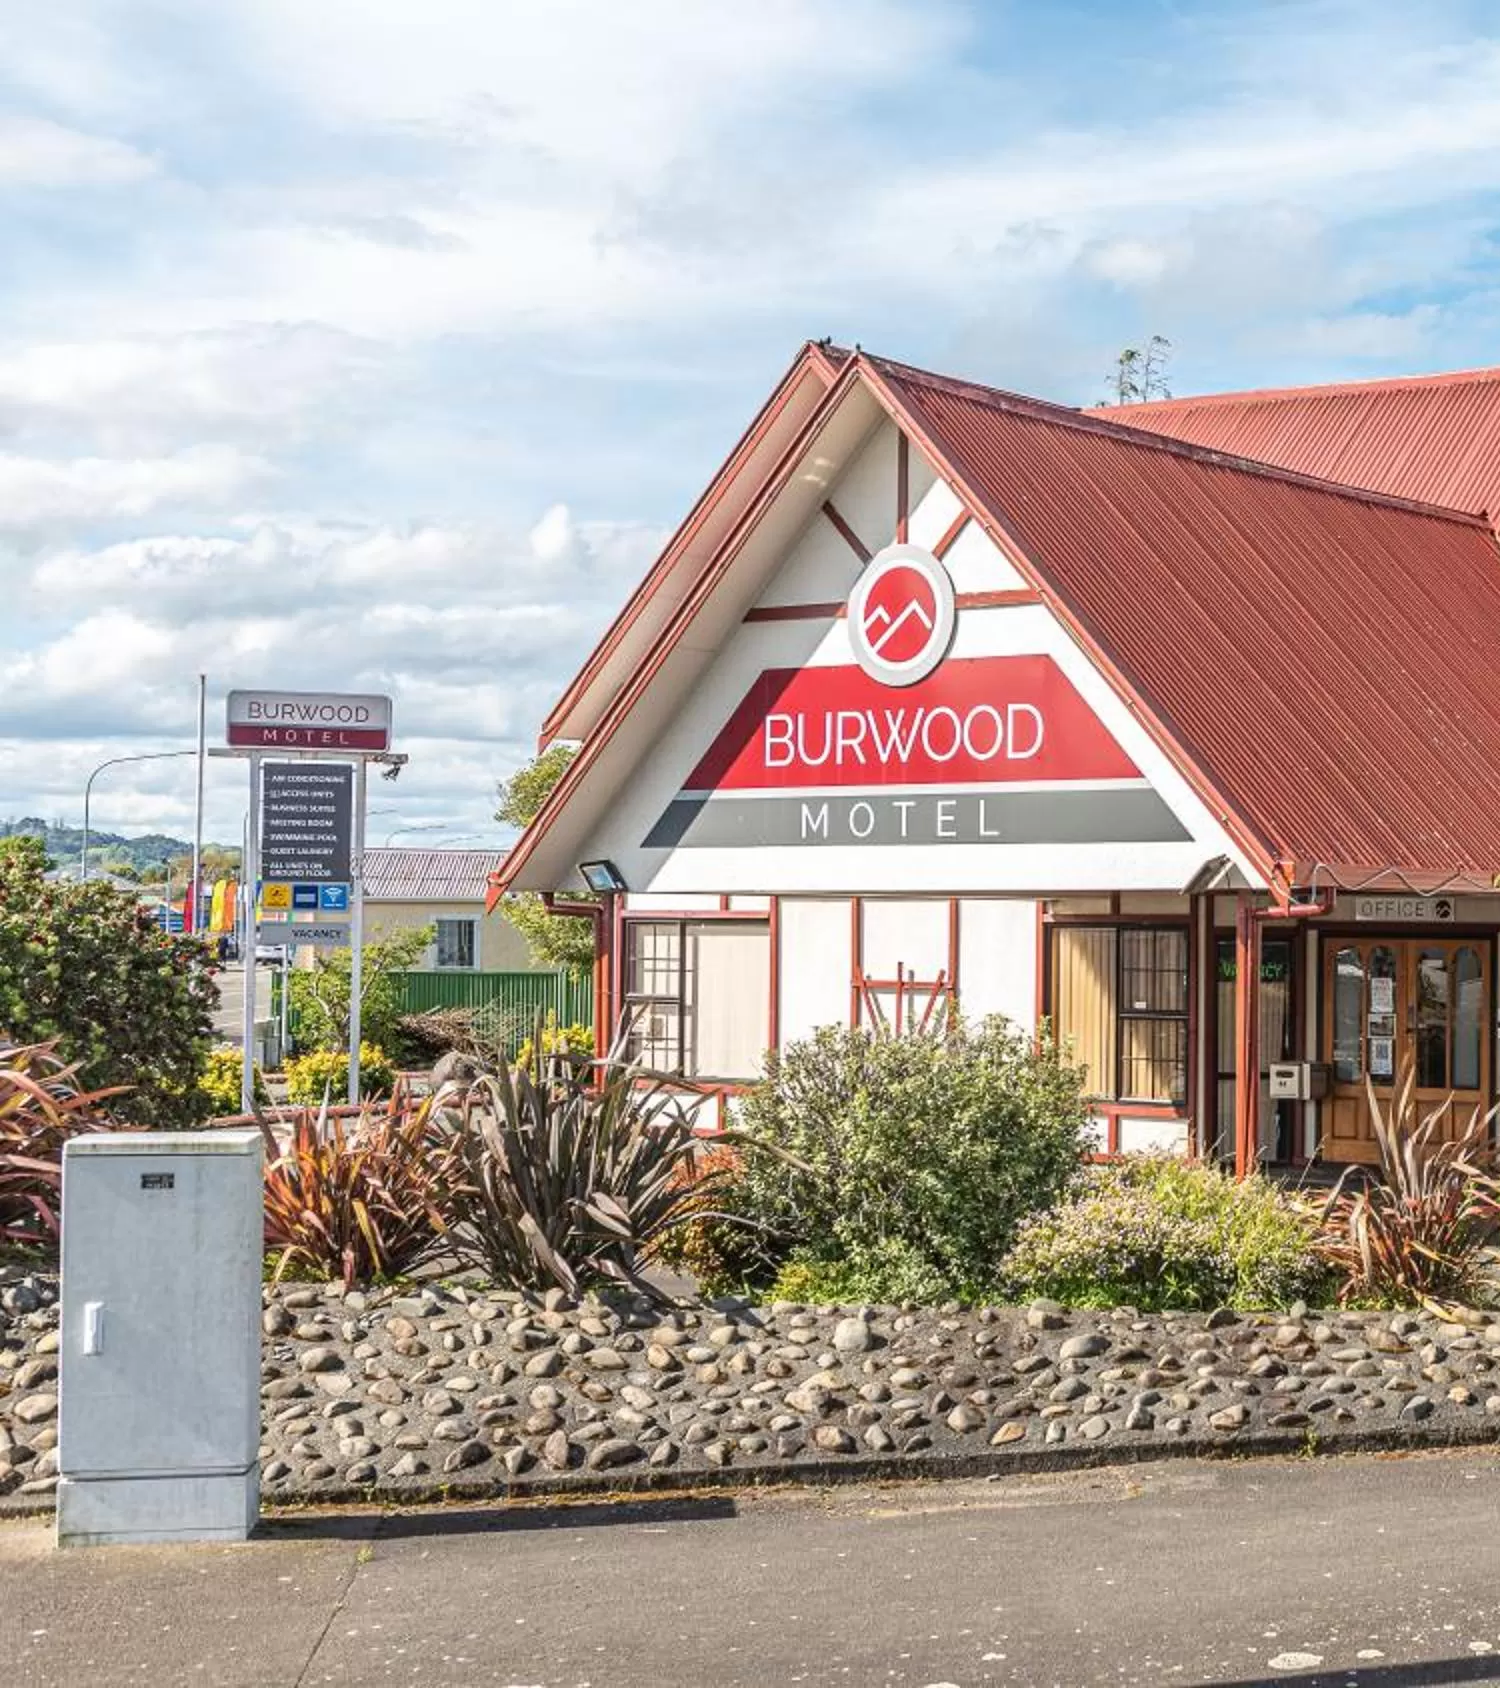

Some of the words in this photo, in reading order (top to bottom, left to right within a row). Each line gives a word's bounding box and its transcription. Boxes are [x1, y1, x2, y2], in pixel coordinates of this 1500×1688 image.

[248, 702, 369, 722] BURWOOD
[263, 729, 349, 744] MOTEL
[764, 703, 1044, 767] BURWOOD
[307, 819, 333, 827] ROOM
[801, 799, 1000, 839] MOTEL
[269, 861, 284, 869] ALL
[269, 869, 304, 877] GROUND
[305, 869, 332, 878] FLOOR
[1361, 901, 1424, 917] OFFICE
[291, 928, 341, 939] VACANCY
